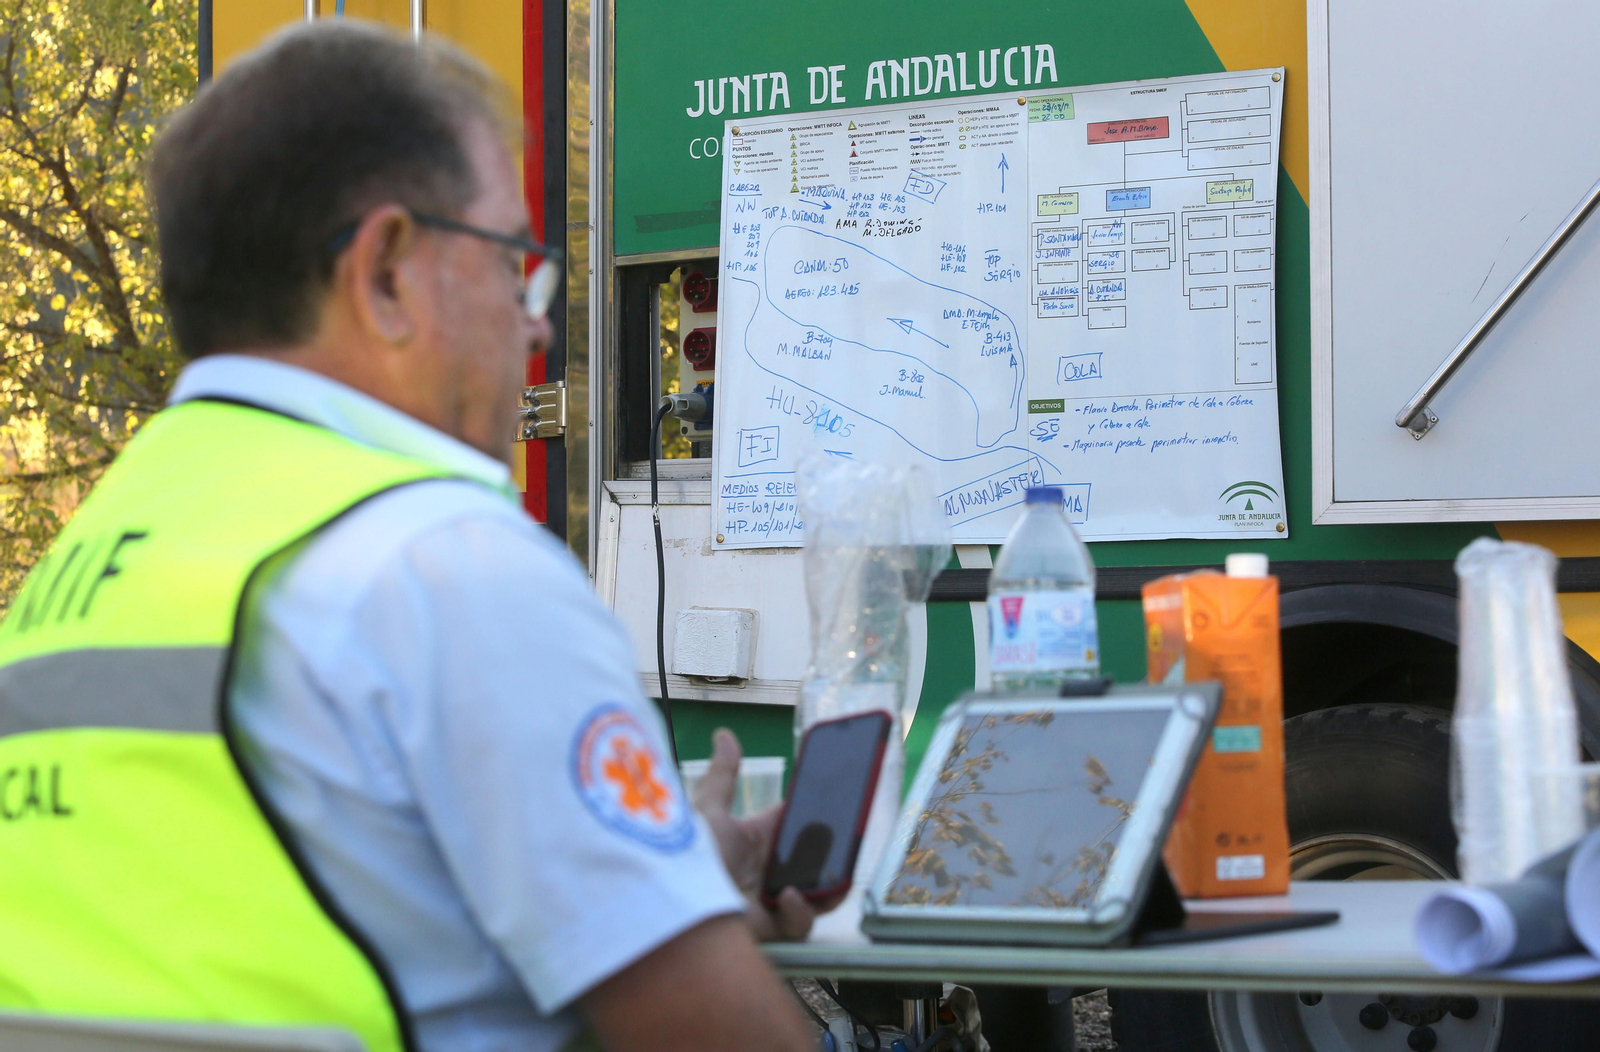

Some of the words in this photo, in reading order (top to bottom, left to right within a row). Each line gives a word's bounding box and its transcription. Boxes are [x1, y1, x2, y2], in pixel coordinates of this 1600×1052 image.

[686, 72, 791, 118] JUNTA
[807, 65, 846, 105] DE
[865, 43, 1058, 100] ANDALUCIA
[835, 218, 857, 229] AMA
[721, 481, 759, 495] MEDIOS
[1248, 512, 1281, 520] ANDALUCIA
